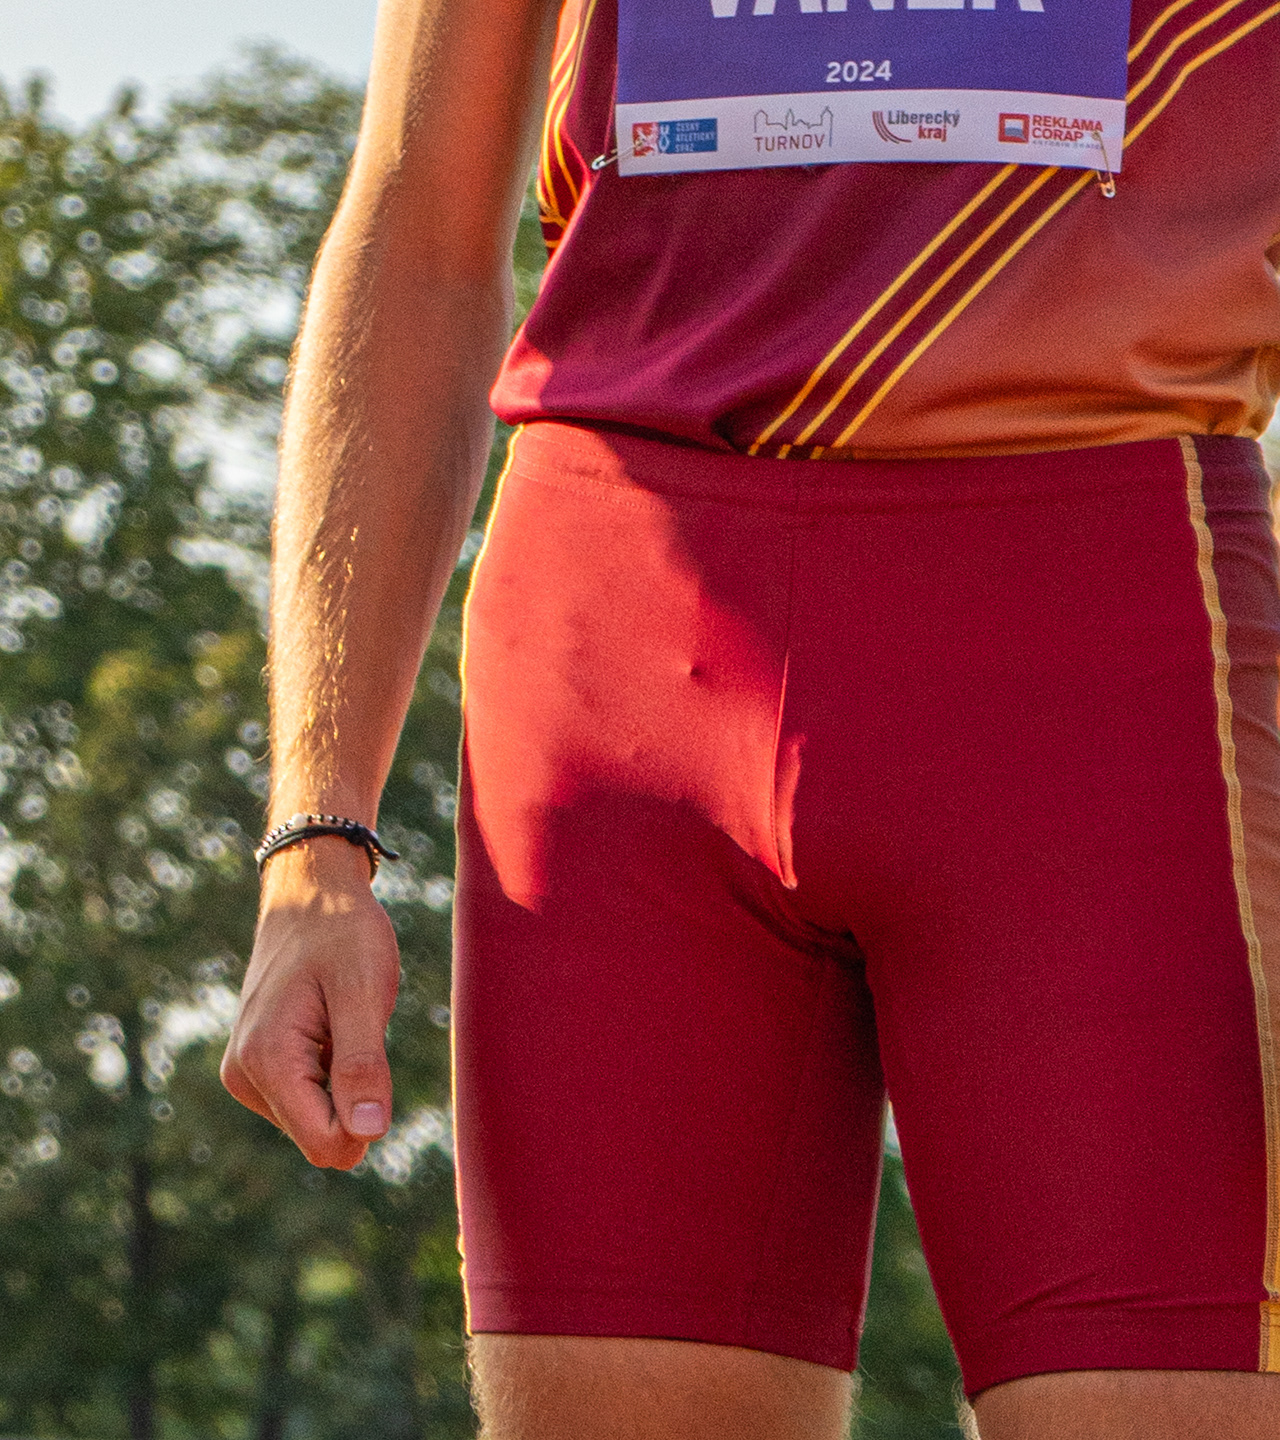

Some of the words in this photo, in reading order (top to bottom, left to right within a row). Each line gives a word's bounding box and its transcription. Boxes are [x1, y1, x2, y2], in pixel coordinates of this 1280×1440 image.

[825, 60, 892, 83] 2024
[887, 109, 960, 128] Liberecký
[1031, 114, 1104, 132] REKLAMA
[755, 134, 825, 152] TURNOV
[918, 126, 947, 143] kraj
[1031, 127, 1084, 142] CORAP
